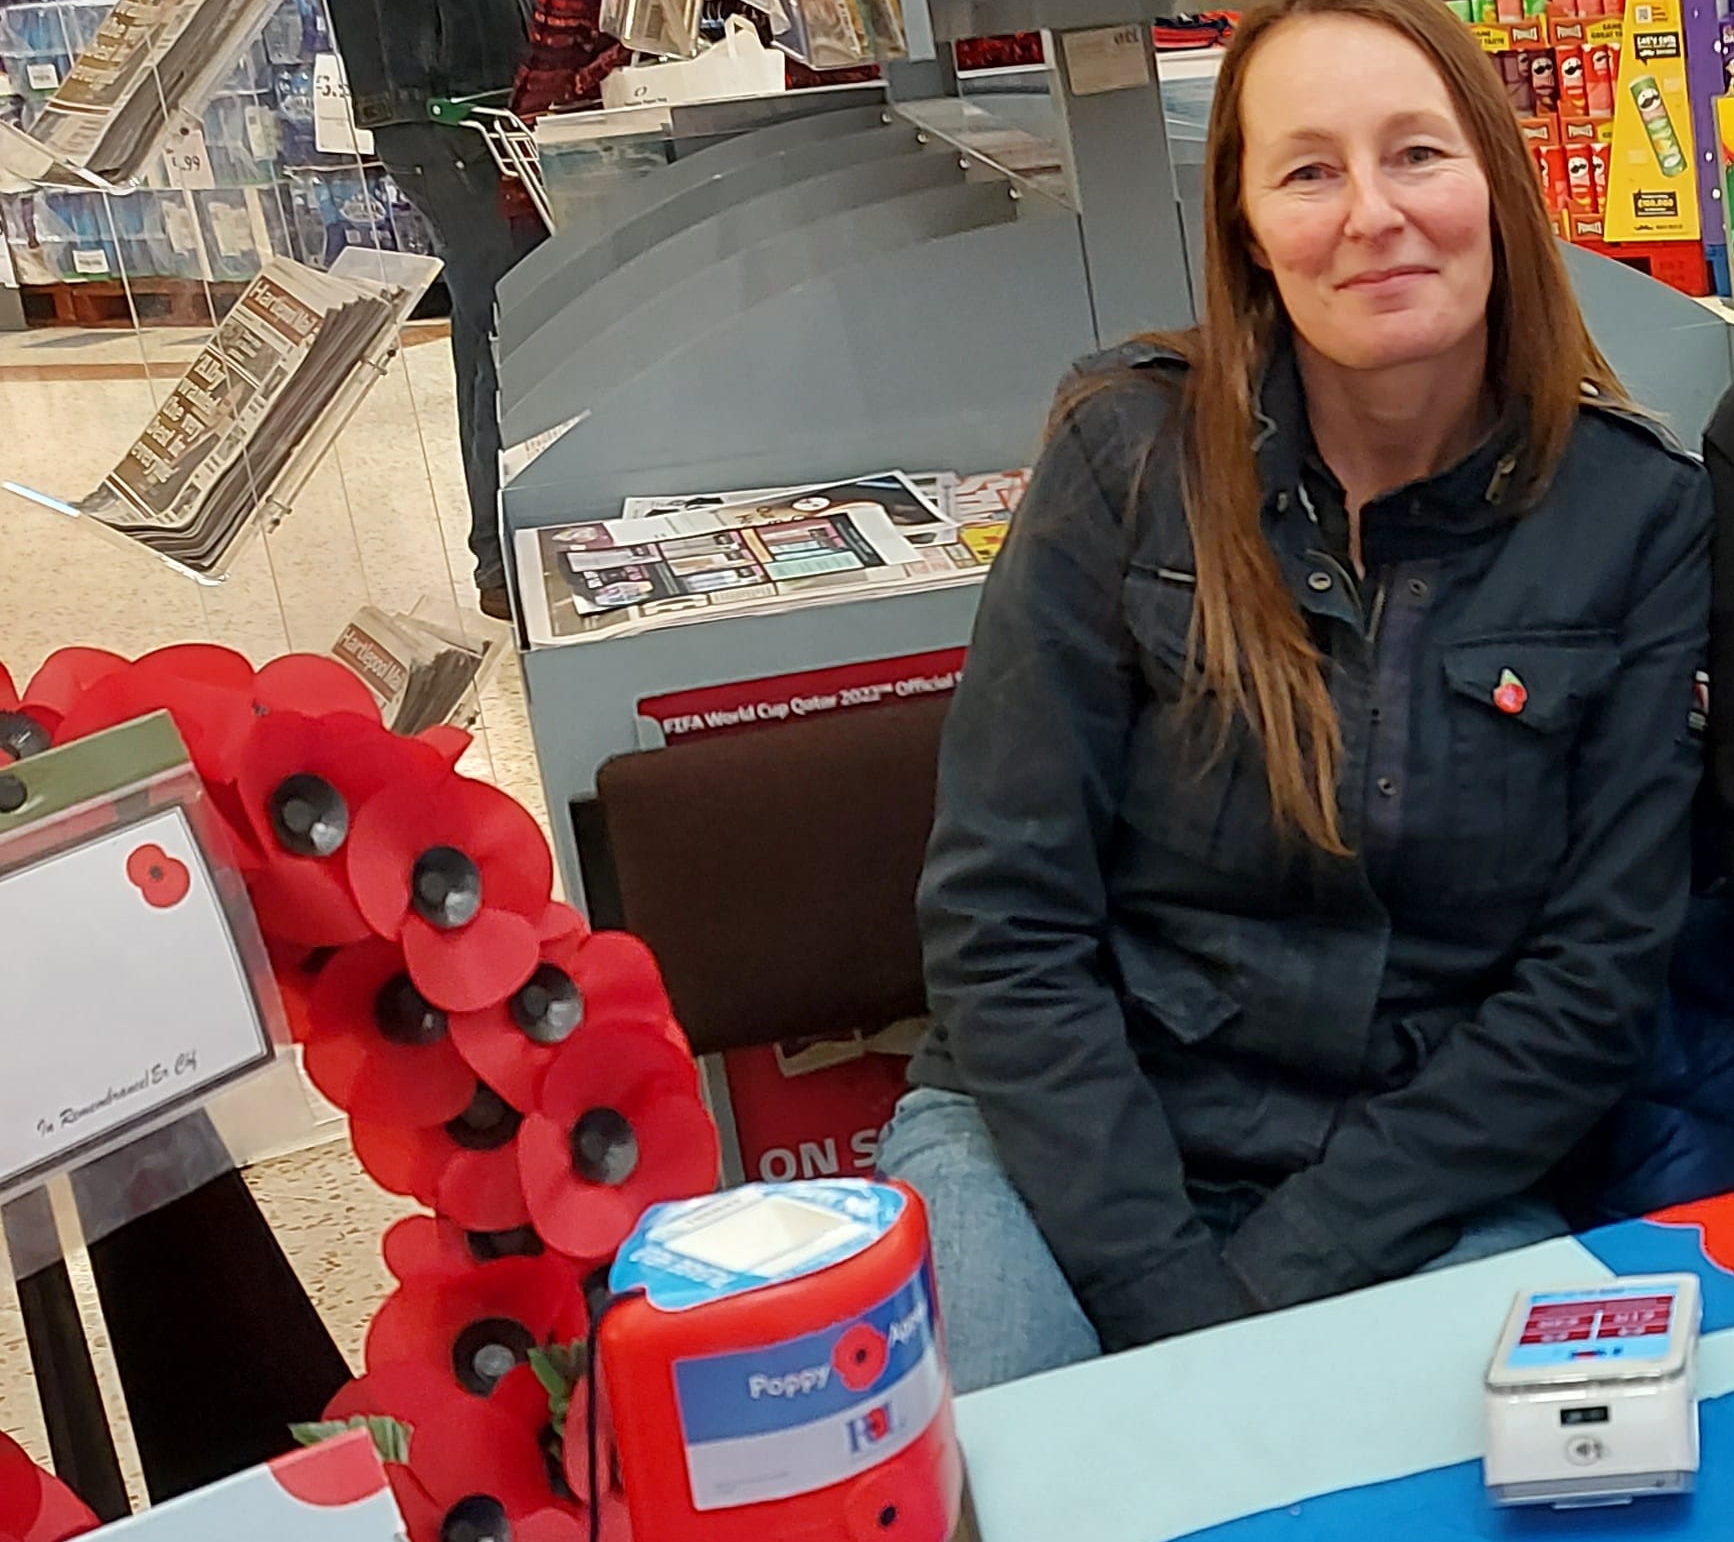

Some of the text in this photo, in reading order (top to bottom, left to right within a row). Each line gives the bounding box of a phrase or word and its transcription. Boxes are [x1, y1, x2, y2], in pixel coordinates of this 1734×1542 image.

[662, 715, 705, 735] FIFA
[705, 706, 756, 727] World
[757, 702, 789, 721] Cup
[790, 696, 838, 715] Qatar
[895, 673, 953, 697] Official
